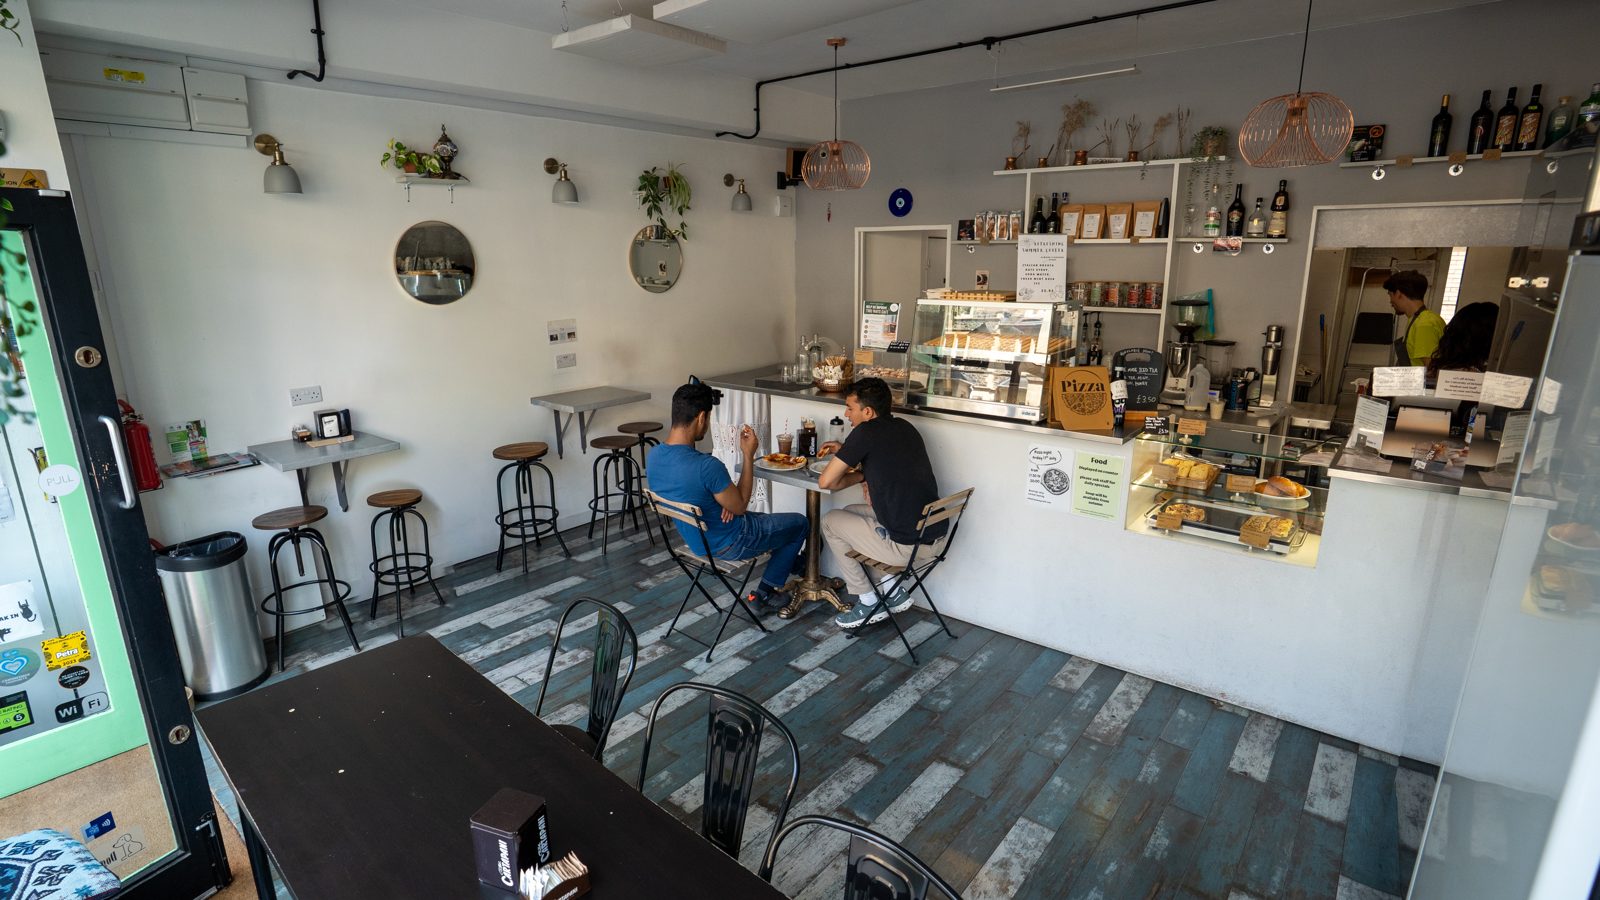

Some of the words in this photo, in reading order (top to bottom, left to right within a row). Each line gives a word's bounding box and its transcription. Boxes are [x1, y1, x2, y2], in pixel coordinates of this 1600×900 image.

[1061, 379, 1105, 392] Pizza
[1136, 395, 1156, 404] £3.50
[47, 474, 74, 486] PULL
[56, 648, 78, 658] Petra
[58, 706, 78, 718] Wi
[88, 698, 101, 709] Fi
[538, 815, 550, 862] CARTAPANI
[498, 839, 513, 886] CARTAPANI
